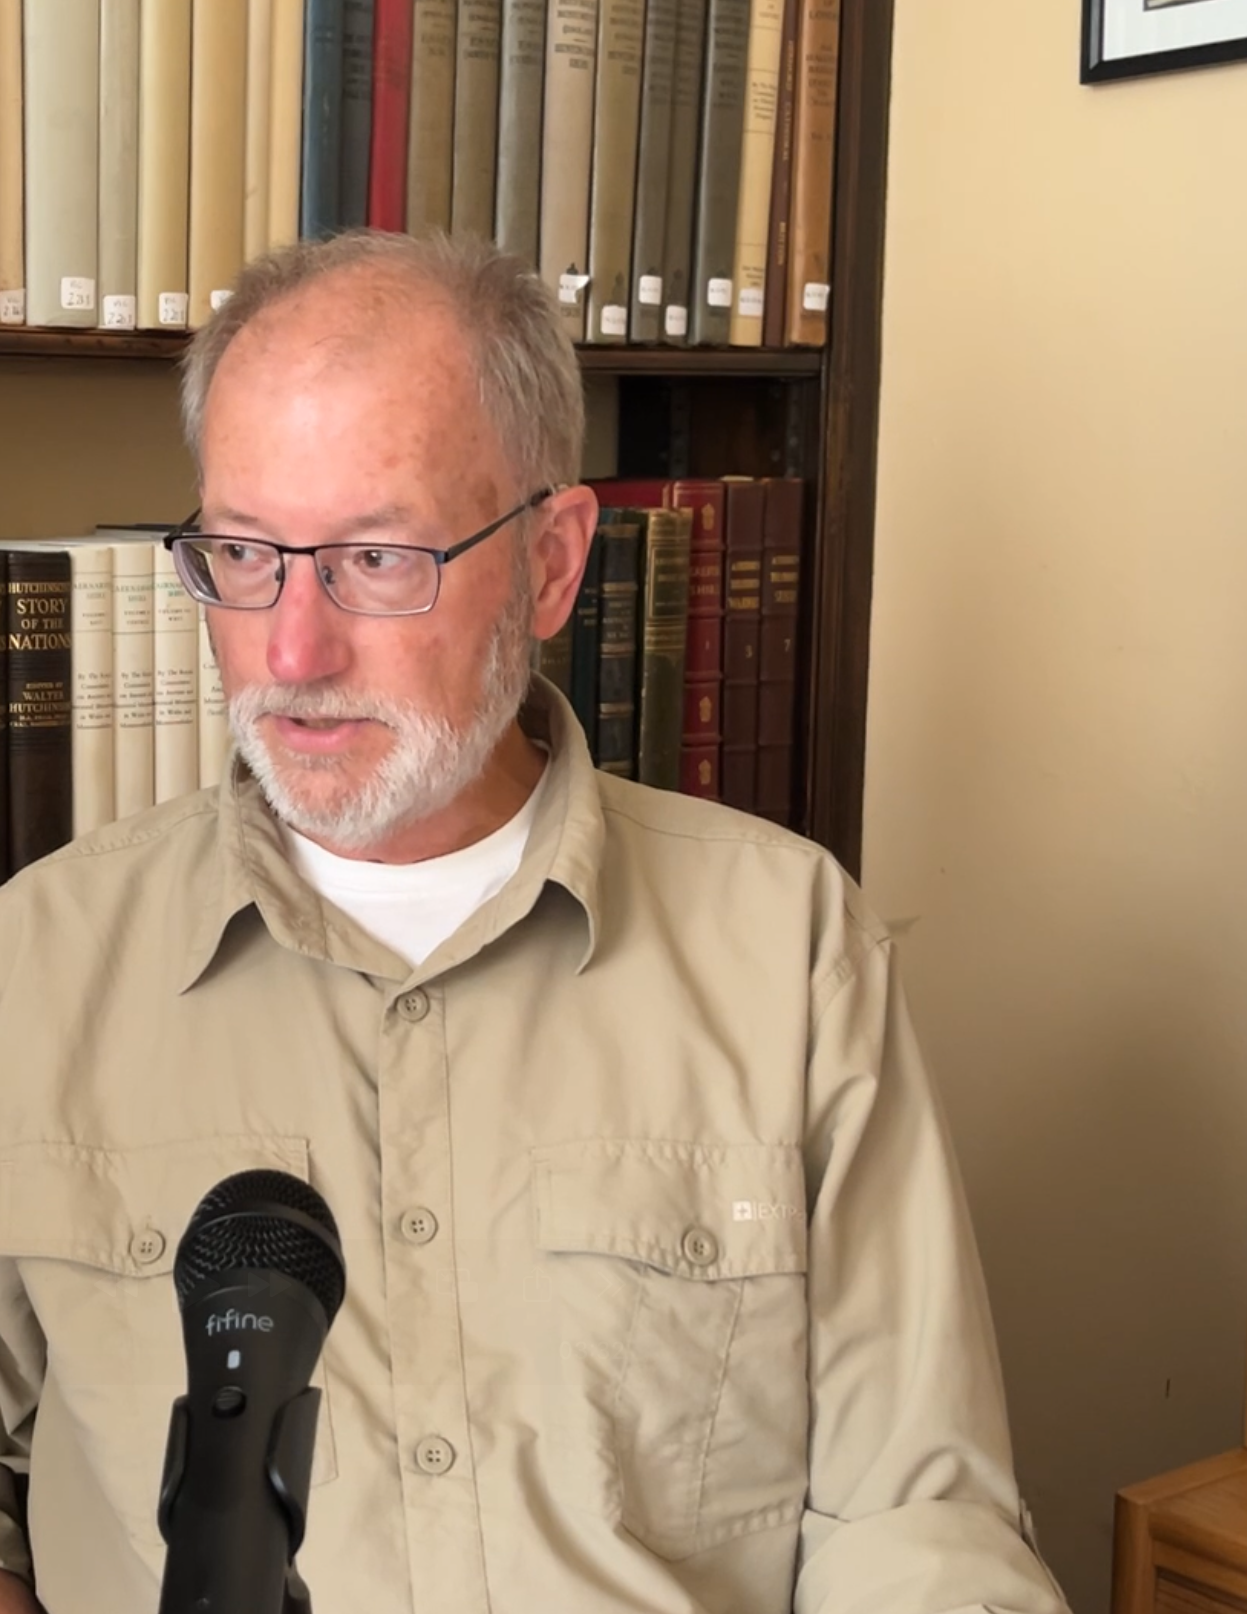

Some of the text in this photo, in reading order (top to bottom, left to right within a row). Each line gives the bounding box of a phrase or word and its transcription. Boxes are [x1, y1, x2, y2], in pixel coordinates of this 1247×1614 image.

[16, 598, 66, 615] STORY
[21, 617, 64, 631] OF THE
[8, 633, 71, 650] NATIONS
[22, 690, 64, 702] WALTER
[206, 1308, 274, 1336] fifine
